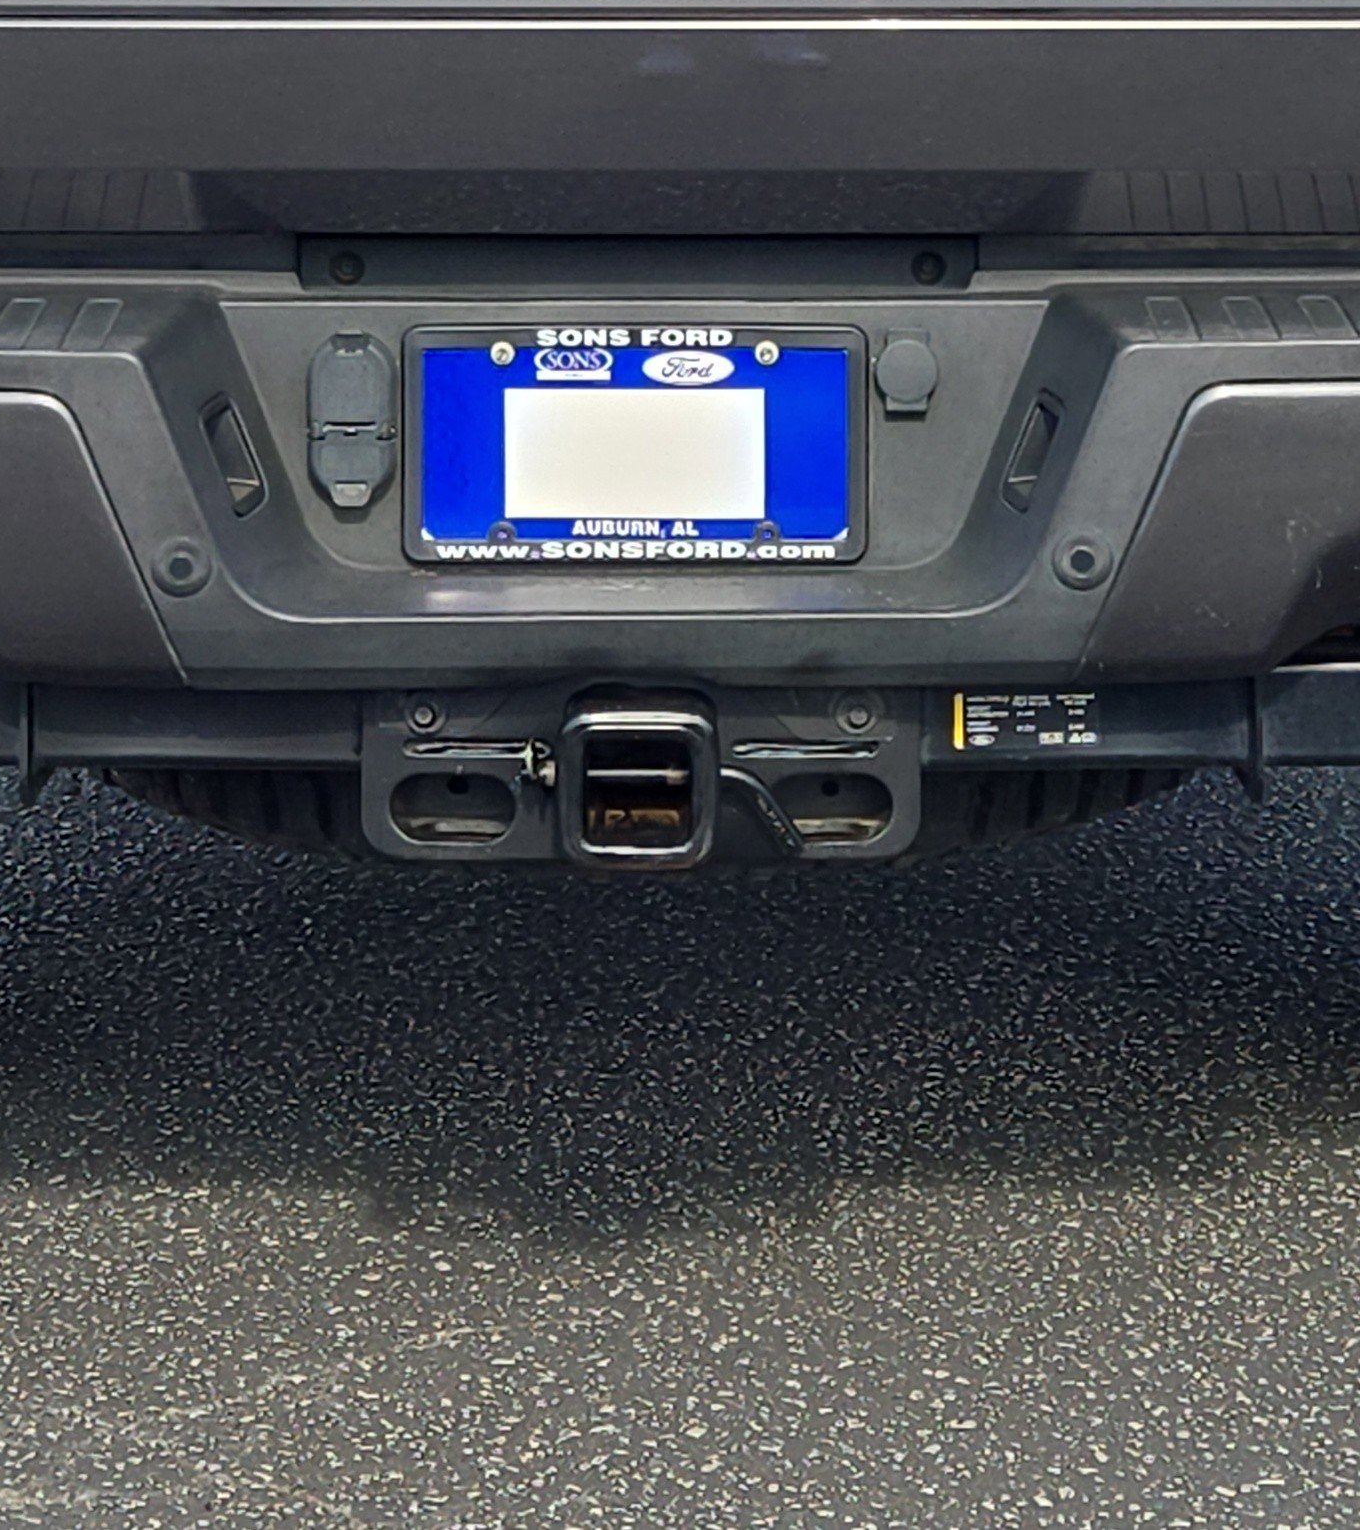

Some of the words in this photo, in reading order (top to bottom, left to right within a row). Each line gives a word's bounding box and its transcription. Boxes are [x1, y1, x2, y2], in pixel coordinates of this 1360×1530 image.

[537, 329, 631, 346] SONS
[641, 329, 733, 347] FORD
[546, 349, 602, 370] SONS
[661, 356, 715, 379] Ford
[671, 520, 699, 537] AL
[437, 540, 836, 559] www.SONSFORD.com
